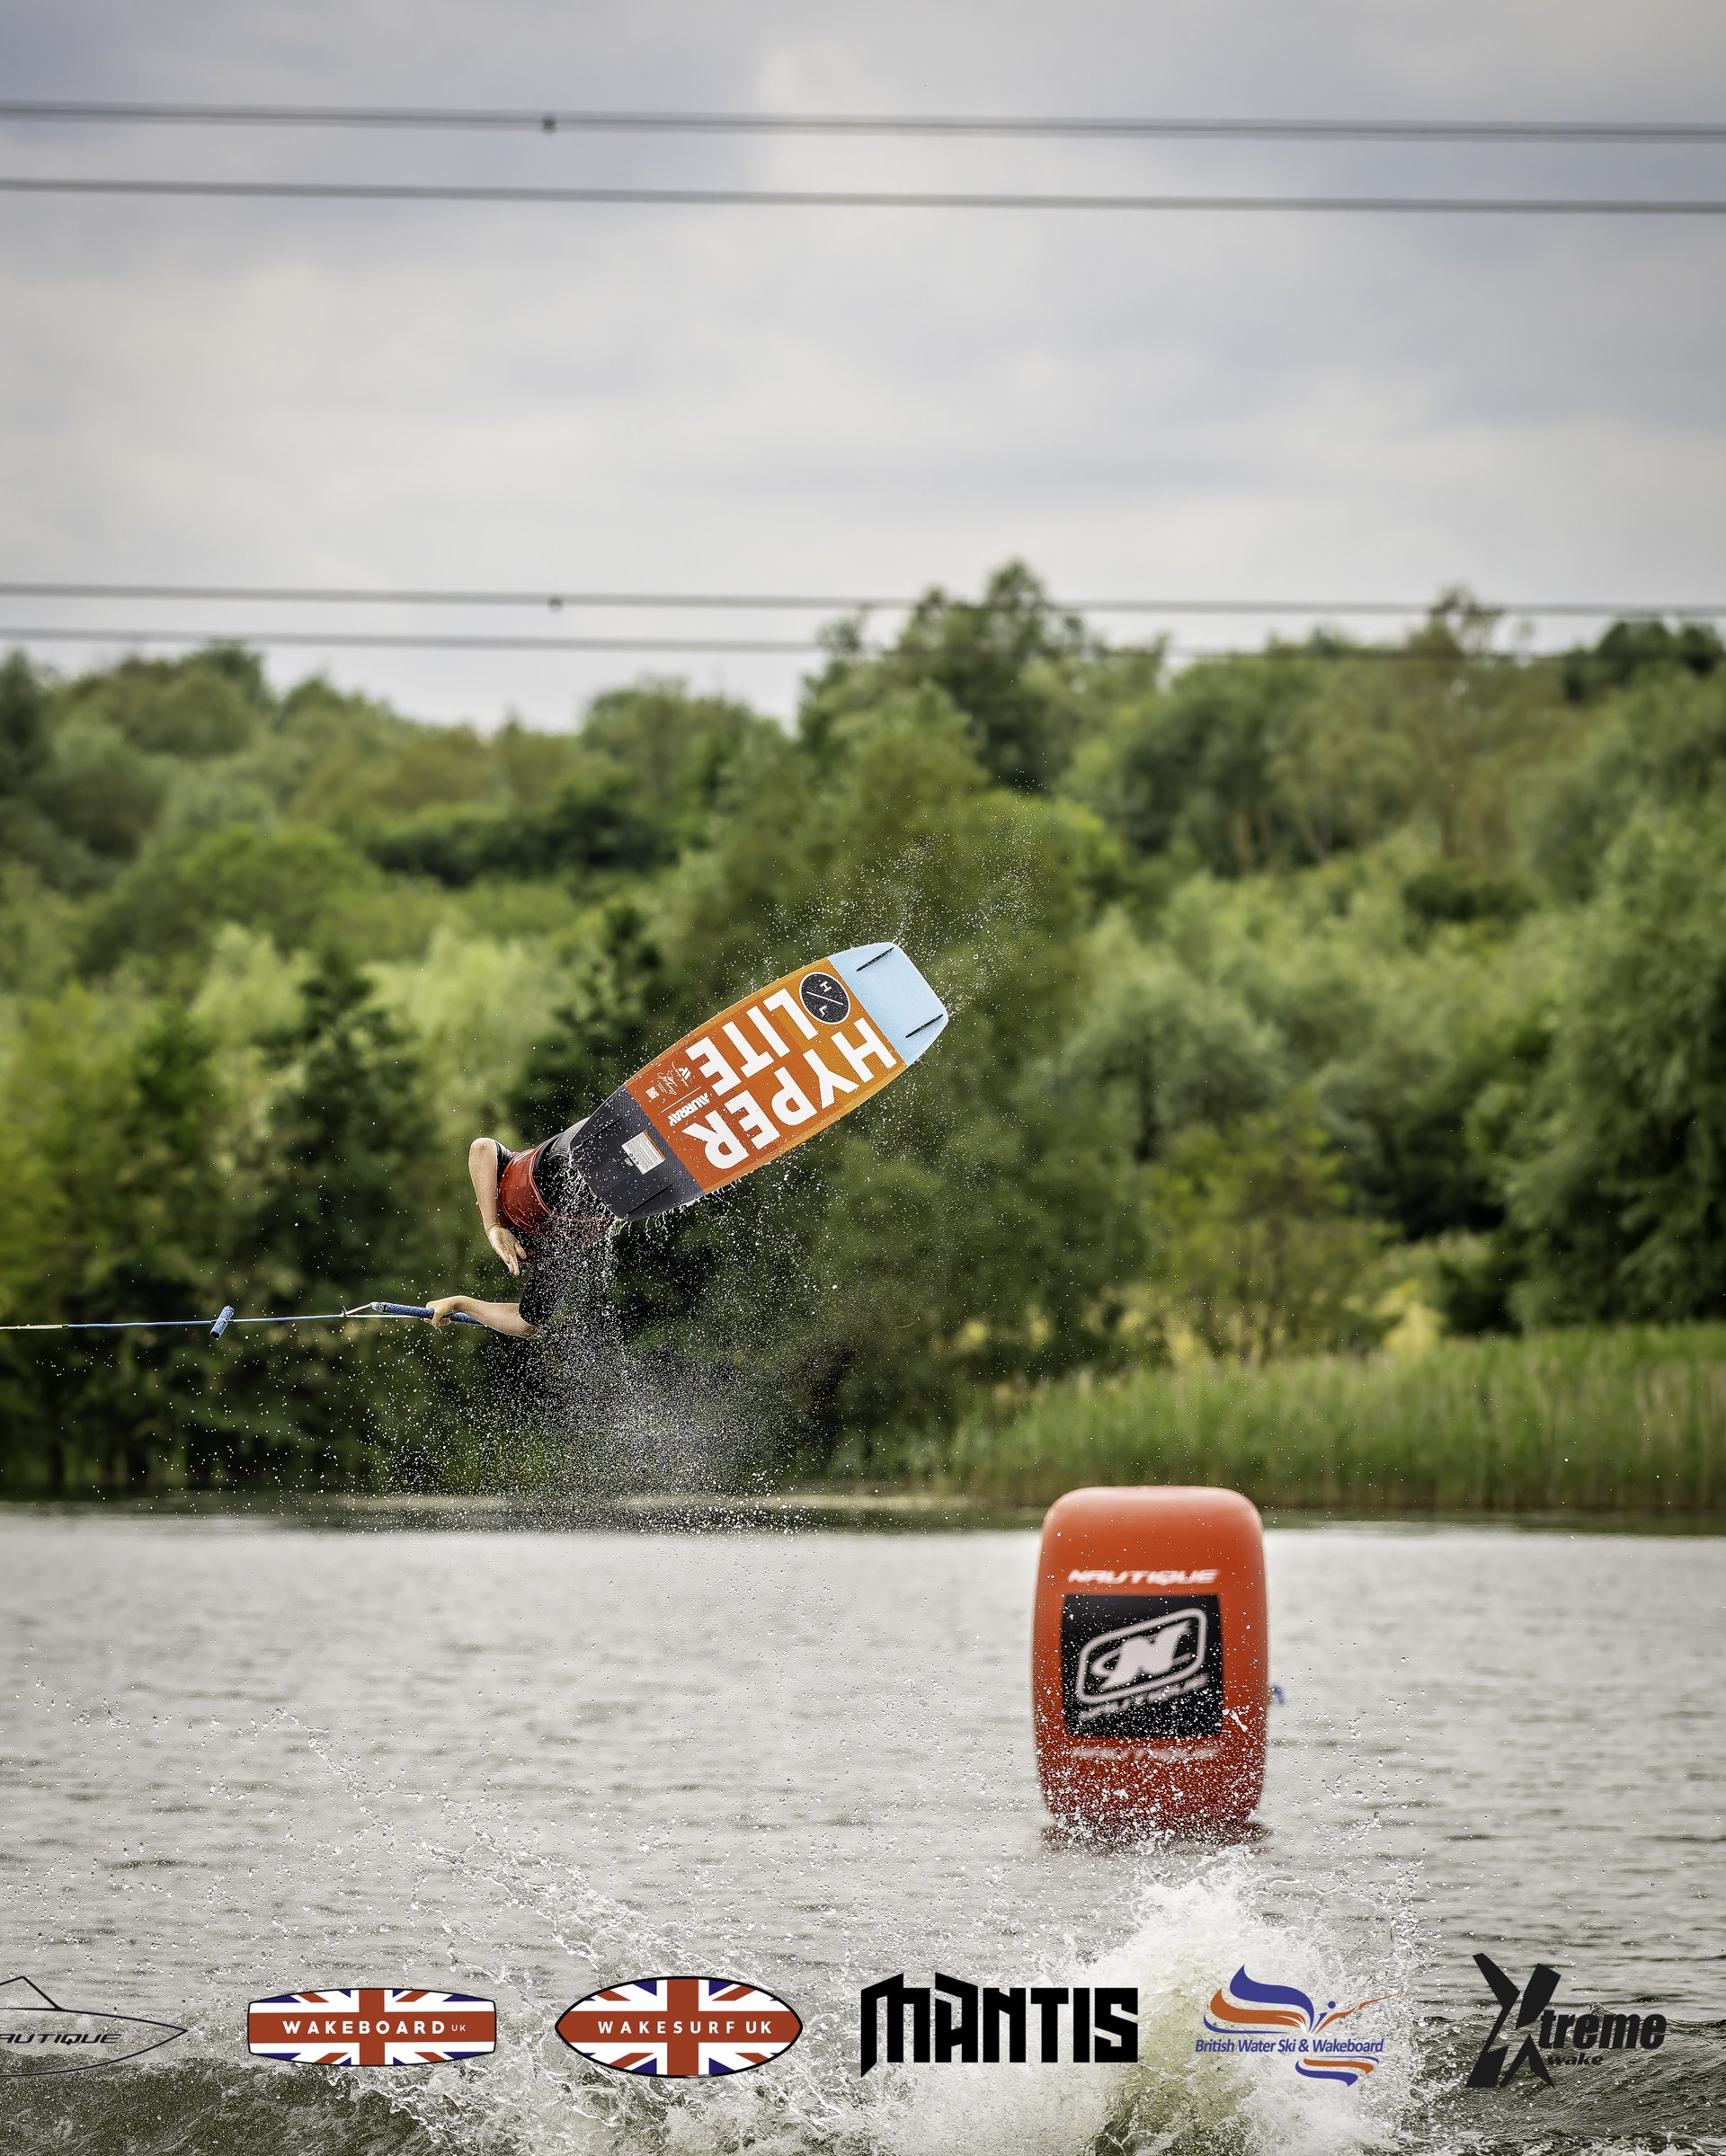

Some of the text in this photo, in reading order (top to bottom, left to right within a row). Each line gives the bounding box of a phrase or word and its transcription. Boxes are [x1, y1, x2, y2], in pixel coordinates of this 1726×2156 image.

[681, 1017, 897, 1169] HYPER
[685, 988, 819, 1096] LITE
[1067, 1569, 1221, 1586] NAUTIQUE
